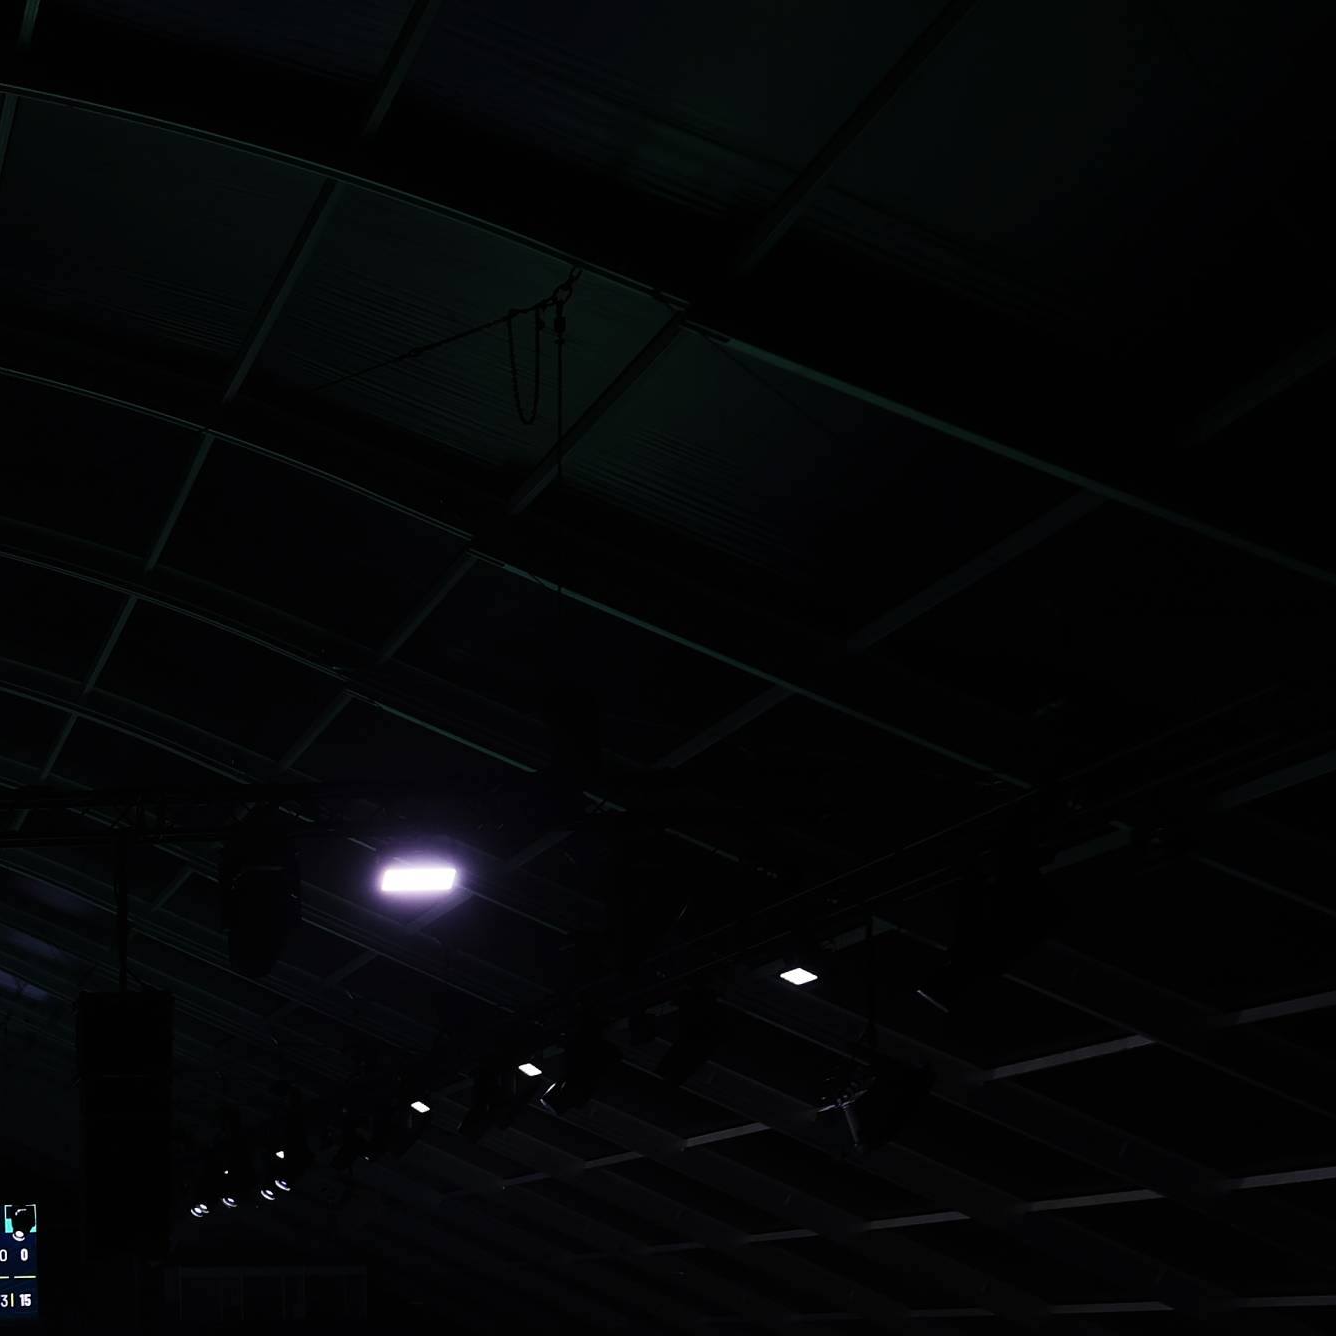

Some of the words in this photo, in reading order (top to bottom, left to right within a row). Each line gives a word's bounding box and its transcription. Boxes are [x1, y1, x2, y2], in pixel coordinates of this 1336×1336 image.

[0, 1249, 8, 1262] 0
[20, 1248, 28, 1261] 0
[0, 1294, 8, 1308] 3
[19, 1293, 32, 1307] 15
